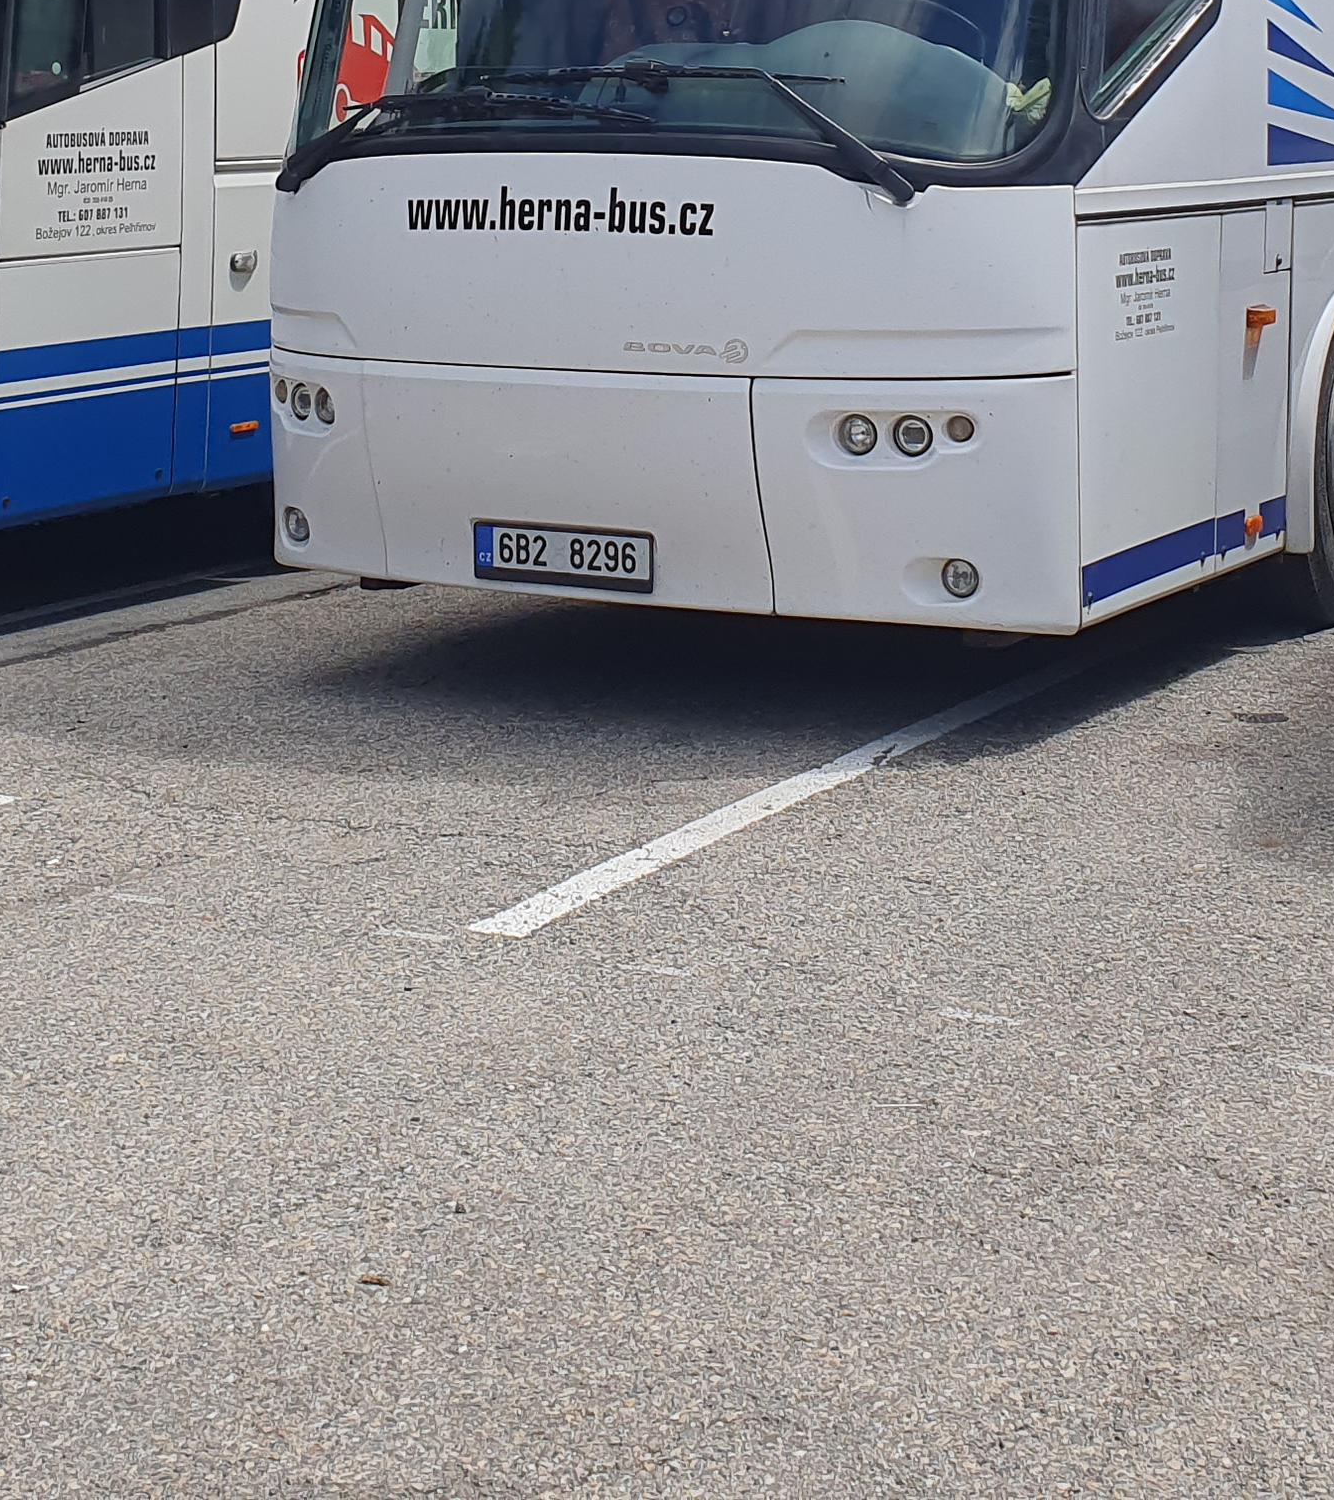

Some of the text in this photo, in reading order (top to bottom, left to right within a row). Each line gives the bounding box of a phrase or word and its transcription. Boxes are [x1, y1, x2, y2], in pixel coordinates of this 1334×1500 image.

[46, 127, 149, 149] AUTOBUSOVÁ DOPRAVA
[38, 149, 156, 175] www.herna-bus.cz
[47, 181, 71, 198] Mgr.
[78, 208, 94, 221] 607
[114, 206, 128, 219] 131
[407, 185, 715, 236] www.herna-bus.cz
[623, 341, 717, 357] BOVA
[479, 551, 491, 563] CZ
[499, 532, 637, 574] 6B2 8296
